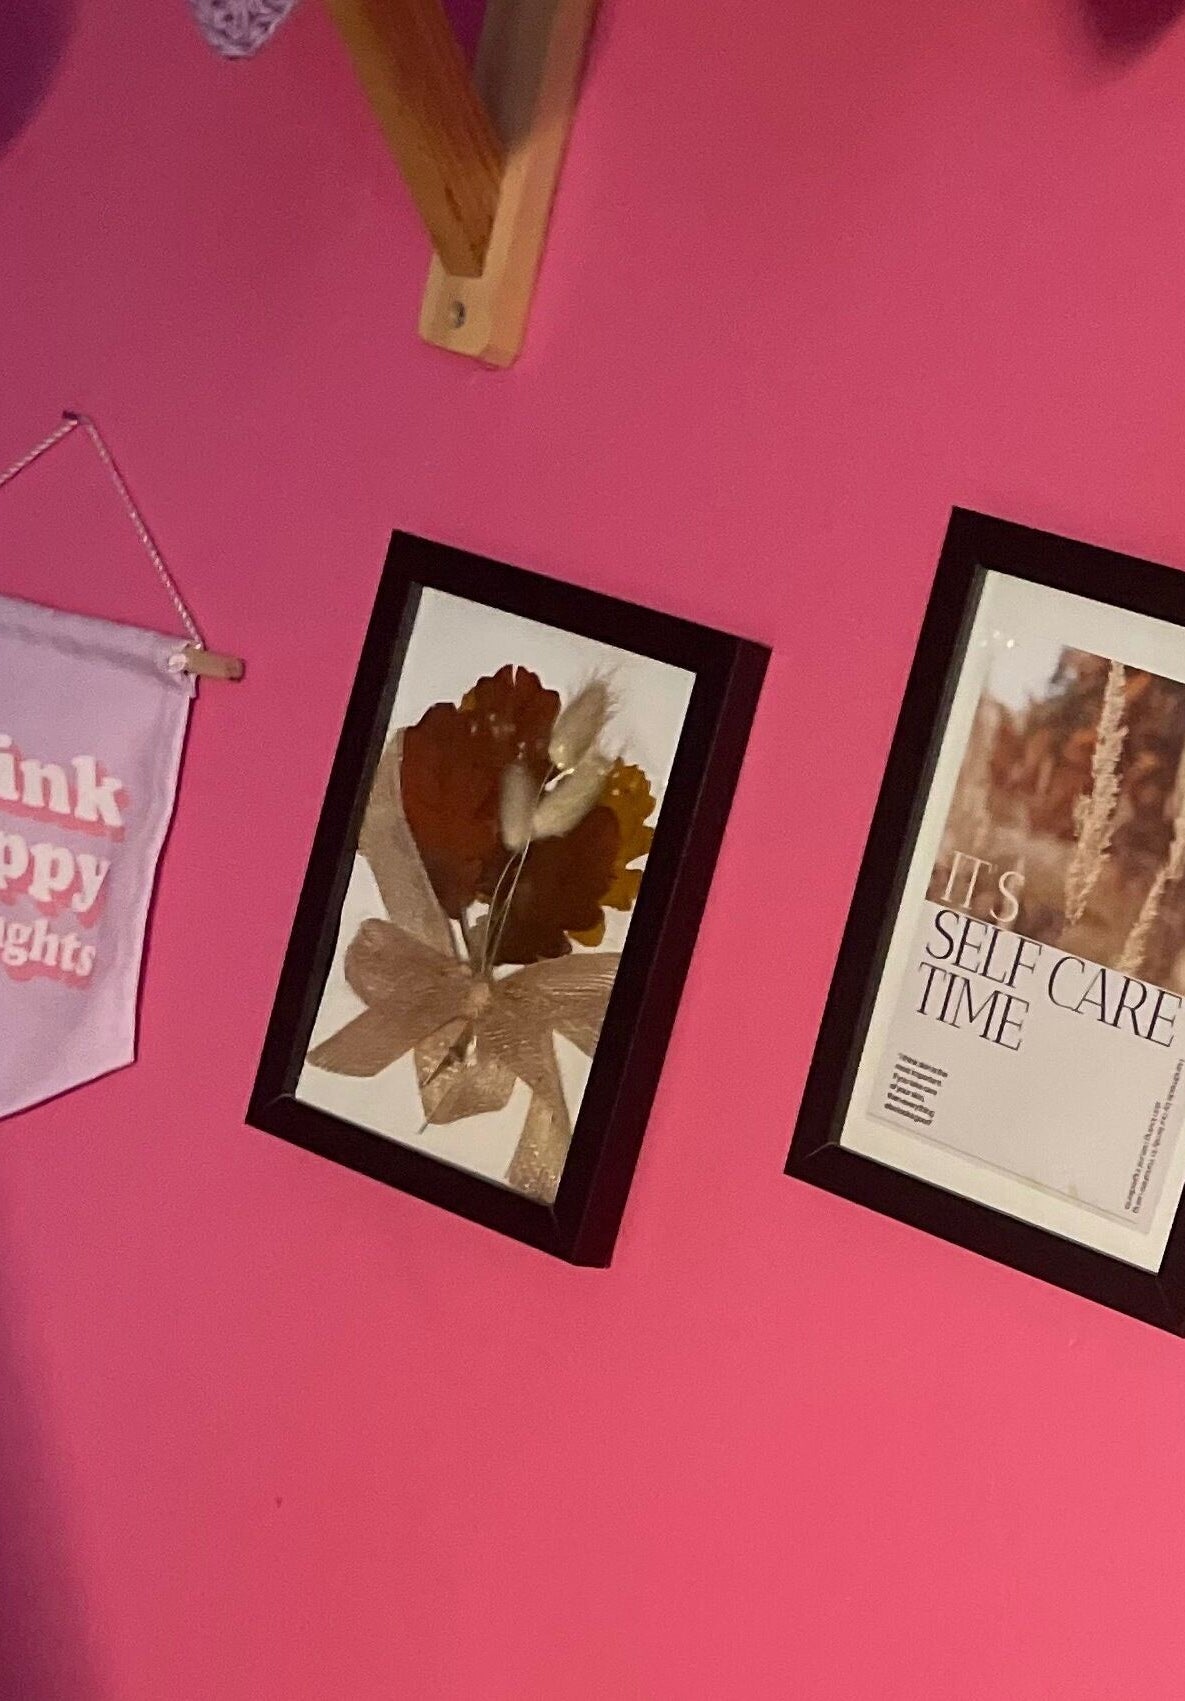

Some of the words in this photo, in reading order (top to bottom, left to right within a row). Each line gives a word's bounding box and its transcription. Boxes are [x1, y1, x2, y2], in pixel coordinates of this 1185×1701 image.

[0, 916, 97, 977] ghts
[926, 909, 1042, 988] SELF
[1048, 956, 1183, 1048] CARE
[916, 961, 1030, 1051] TIME
